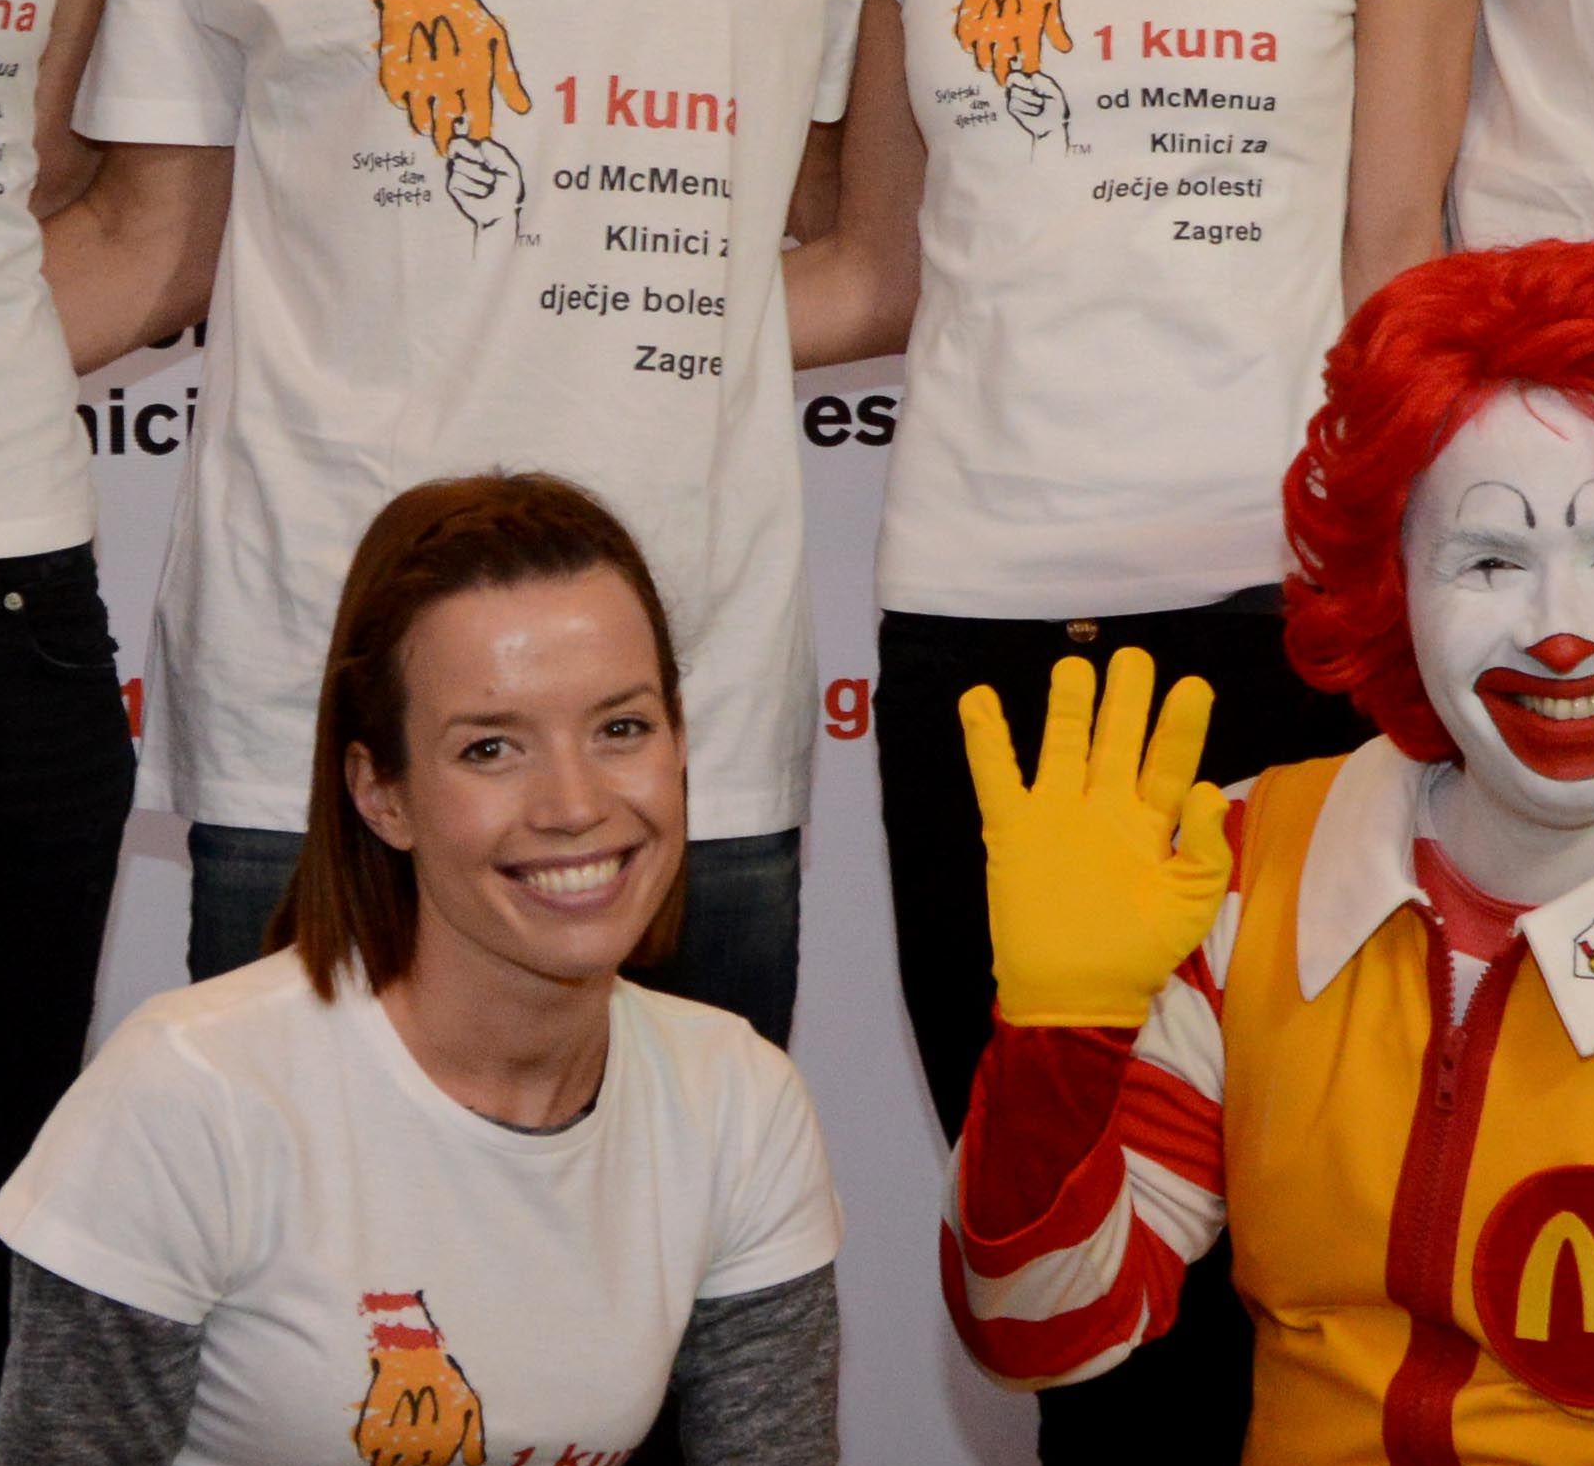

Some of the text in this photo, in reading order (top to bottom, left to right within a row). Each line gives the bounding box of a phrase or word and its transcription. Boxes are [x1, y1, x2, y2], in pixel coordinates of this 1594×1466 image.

[1094, 20, 1278, 63] 1 kuna
[554, 75, 578, 125] 1
[1096, 87, 1276, 113] od McMenua
[1150, 132, 1268, 155] Klinici za
[554, 164, 732, 199] od McMenu
[1092, 177, 1262, 201] dječje bolesti
[605, 225, 709, 257] Klinici
[1172, 221, 1262, 245] Zagreb
[540, 283, 725, 317] dječje boles
[634, 345, 722, 378] Zagre
